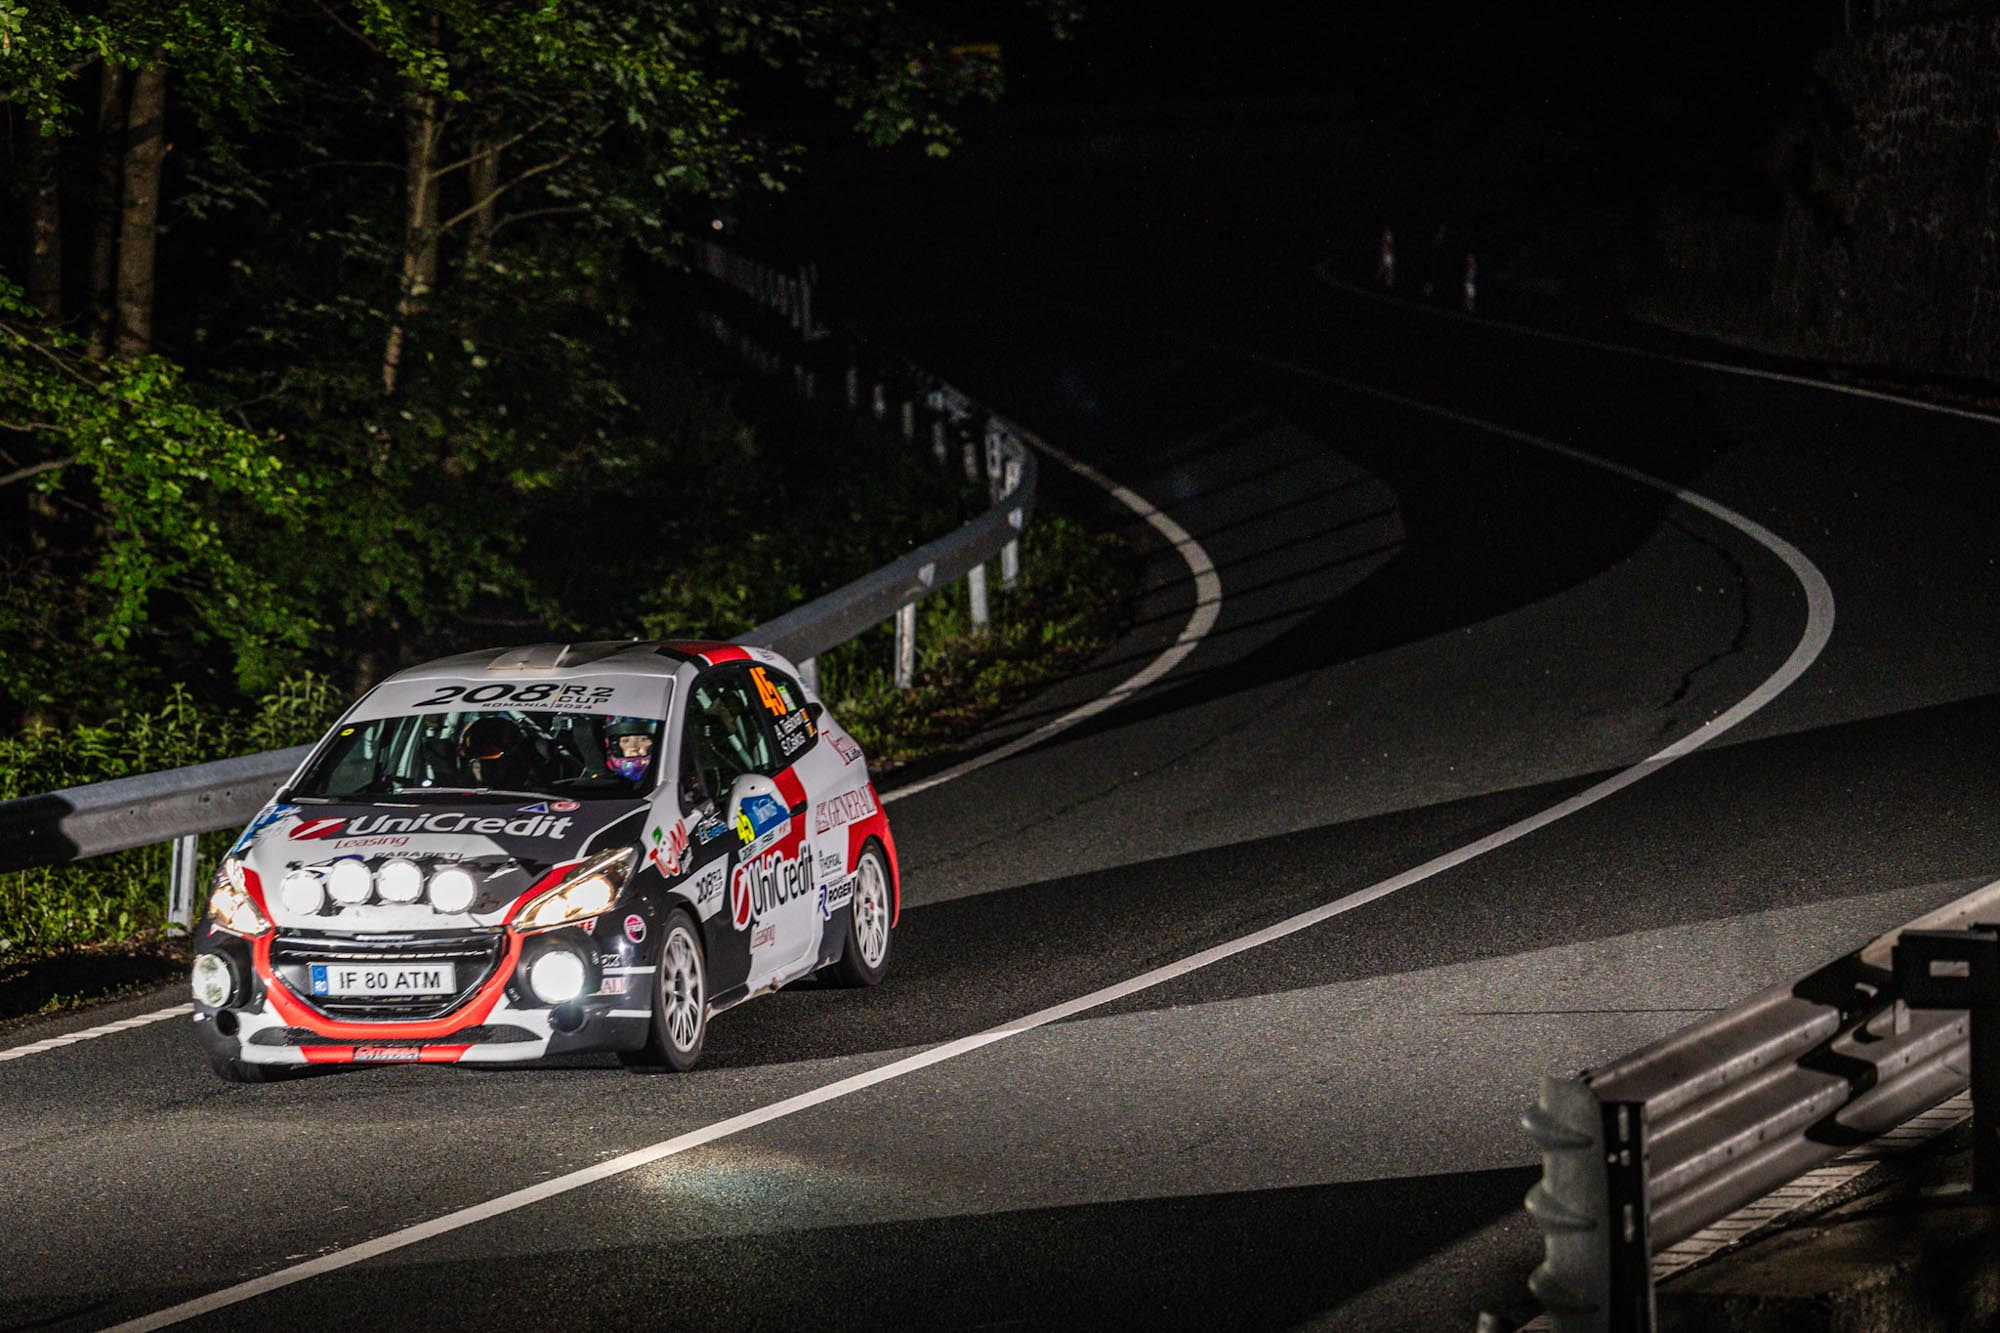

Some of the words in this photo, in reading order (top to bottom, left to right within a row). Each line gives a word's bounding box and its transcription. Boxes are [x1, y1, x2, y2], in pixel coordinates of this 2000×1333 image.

[411, 683, 561, 707] 208
[562, 684, 615, 697] R2
[558, 695, 610, 705] CUP
[749, 666, 787, 716] 45
[345, 812, 573, 840] UniCredit
[333, 834, 411, 850] Leasing
[751, 845, 815, 917] UniCredit
[339, 972, 357, 989] IF
[365, 972, 388, 989] 80
[395, 971, 441, 989] ATM
